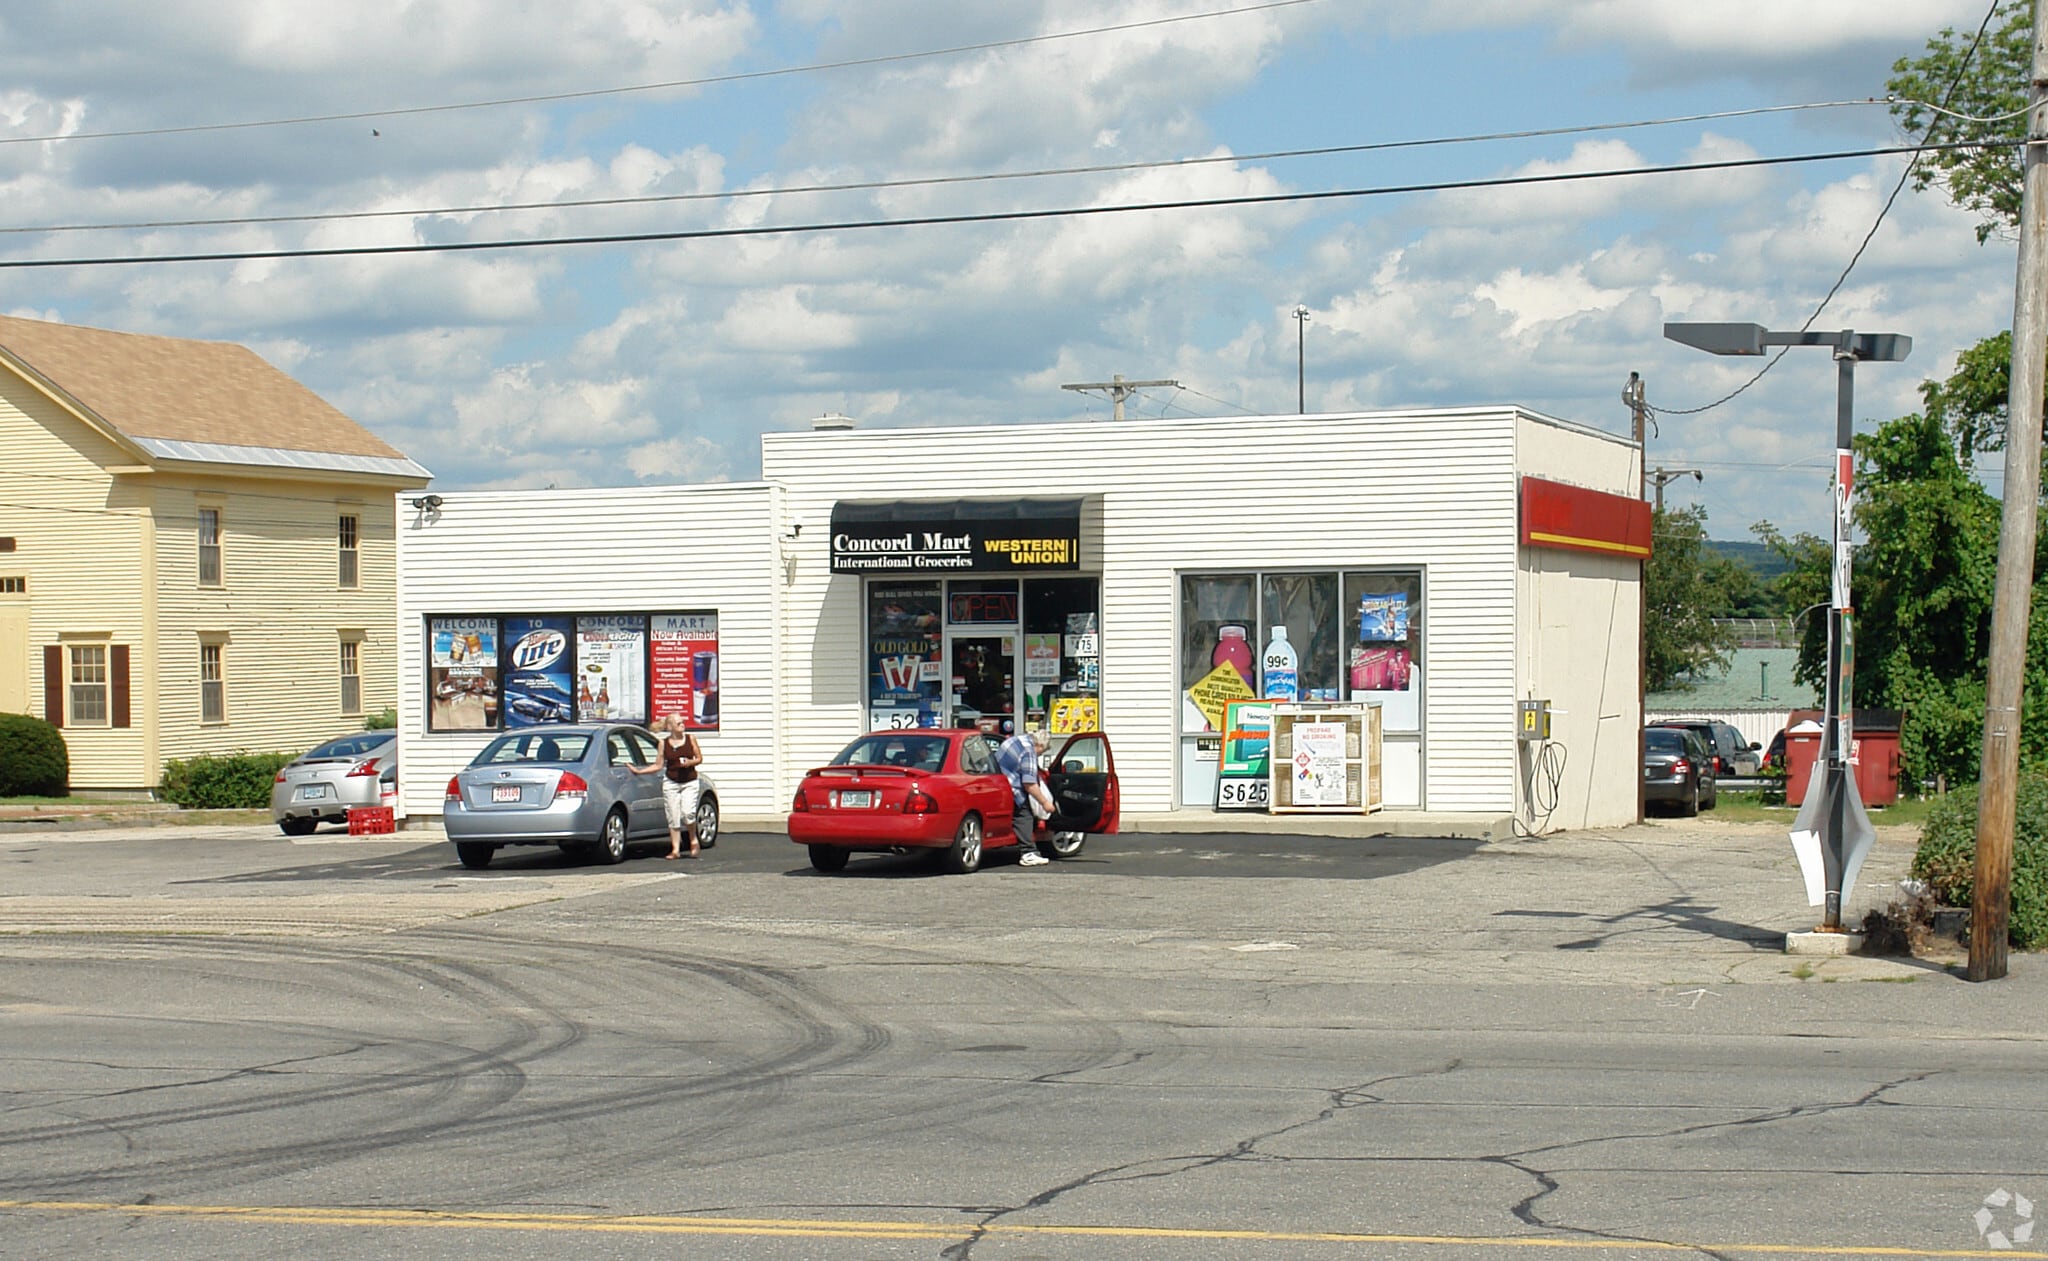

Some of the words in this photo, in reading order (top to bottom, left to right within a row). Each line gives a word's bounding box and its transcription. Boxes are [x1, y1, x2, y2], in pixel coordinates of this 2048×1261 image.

[834, 533, 912, 551] Concord
[922, 532, 971, 550] Mart
[984, 539, 1065, 552] WESTERN
[834, 555, 912, 568] International
[914, 555, 973, 567] Groceries
[1011, 551, 1065, 564] UNION
[952, 595, 1016, 620] OPEN
[432, 619, 497, 629] WELCOME
[528, 619, 543, 628] TO
[578, 616, 644, 627] CONCORD
[667, 617, 705, 628] MART
[652, 629, 673, 639] Now
[676, 629, 718, 639] Available
[874, 640, 896, 654] OLD
[897, 640, 928, 654] GOLD
[1223, 783, 1268, 802] $625
